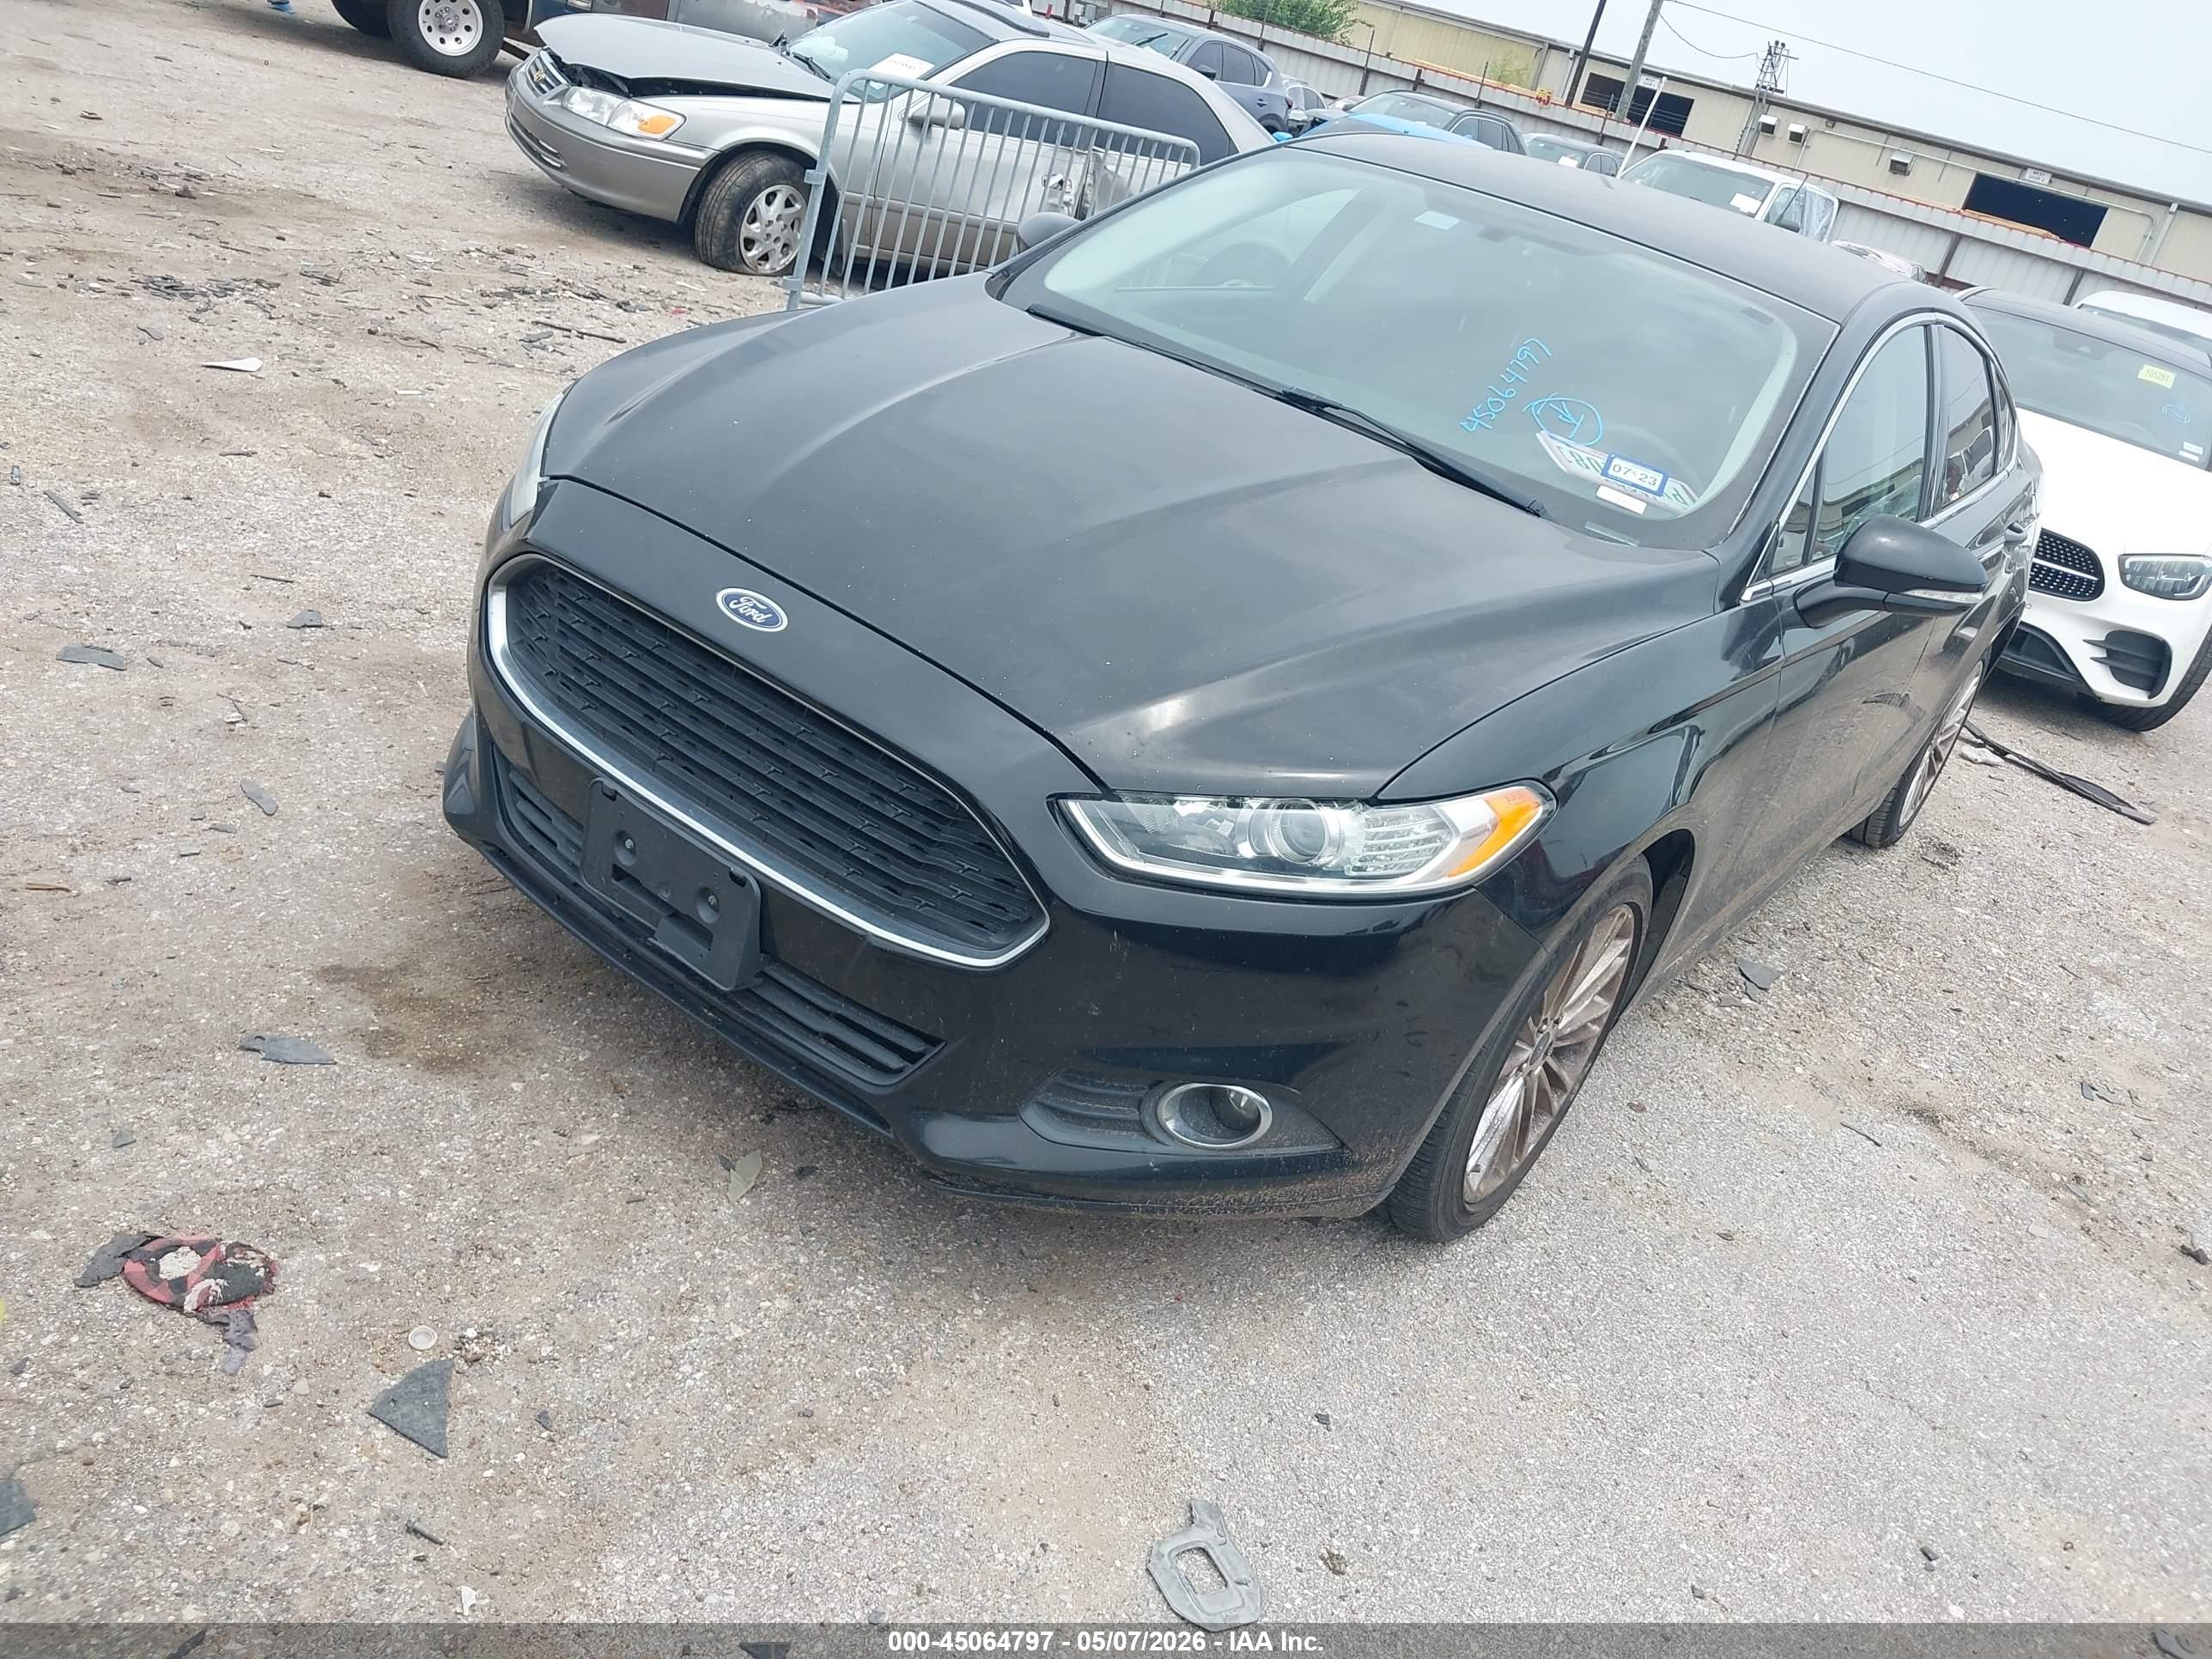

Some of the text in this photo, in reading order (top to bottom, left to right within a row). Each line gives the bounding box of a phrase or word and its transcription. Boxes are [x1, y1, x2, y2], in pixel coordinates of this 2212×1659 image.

[1460, 337, 1552, 432] 45064797
[1613, 464, 1657, 486] 07 23
[729, 596, 773, 623] Ford
